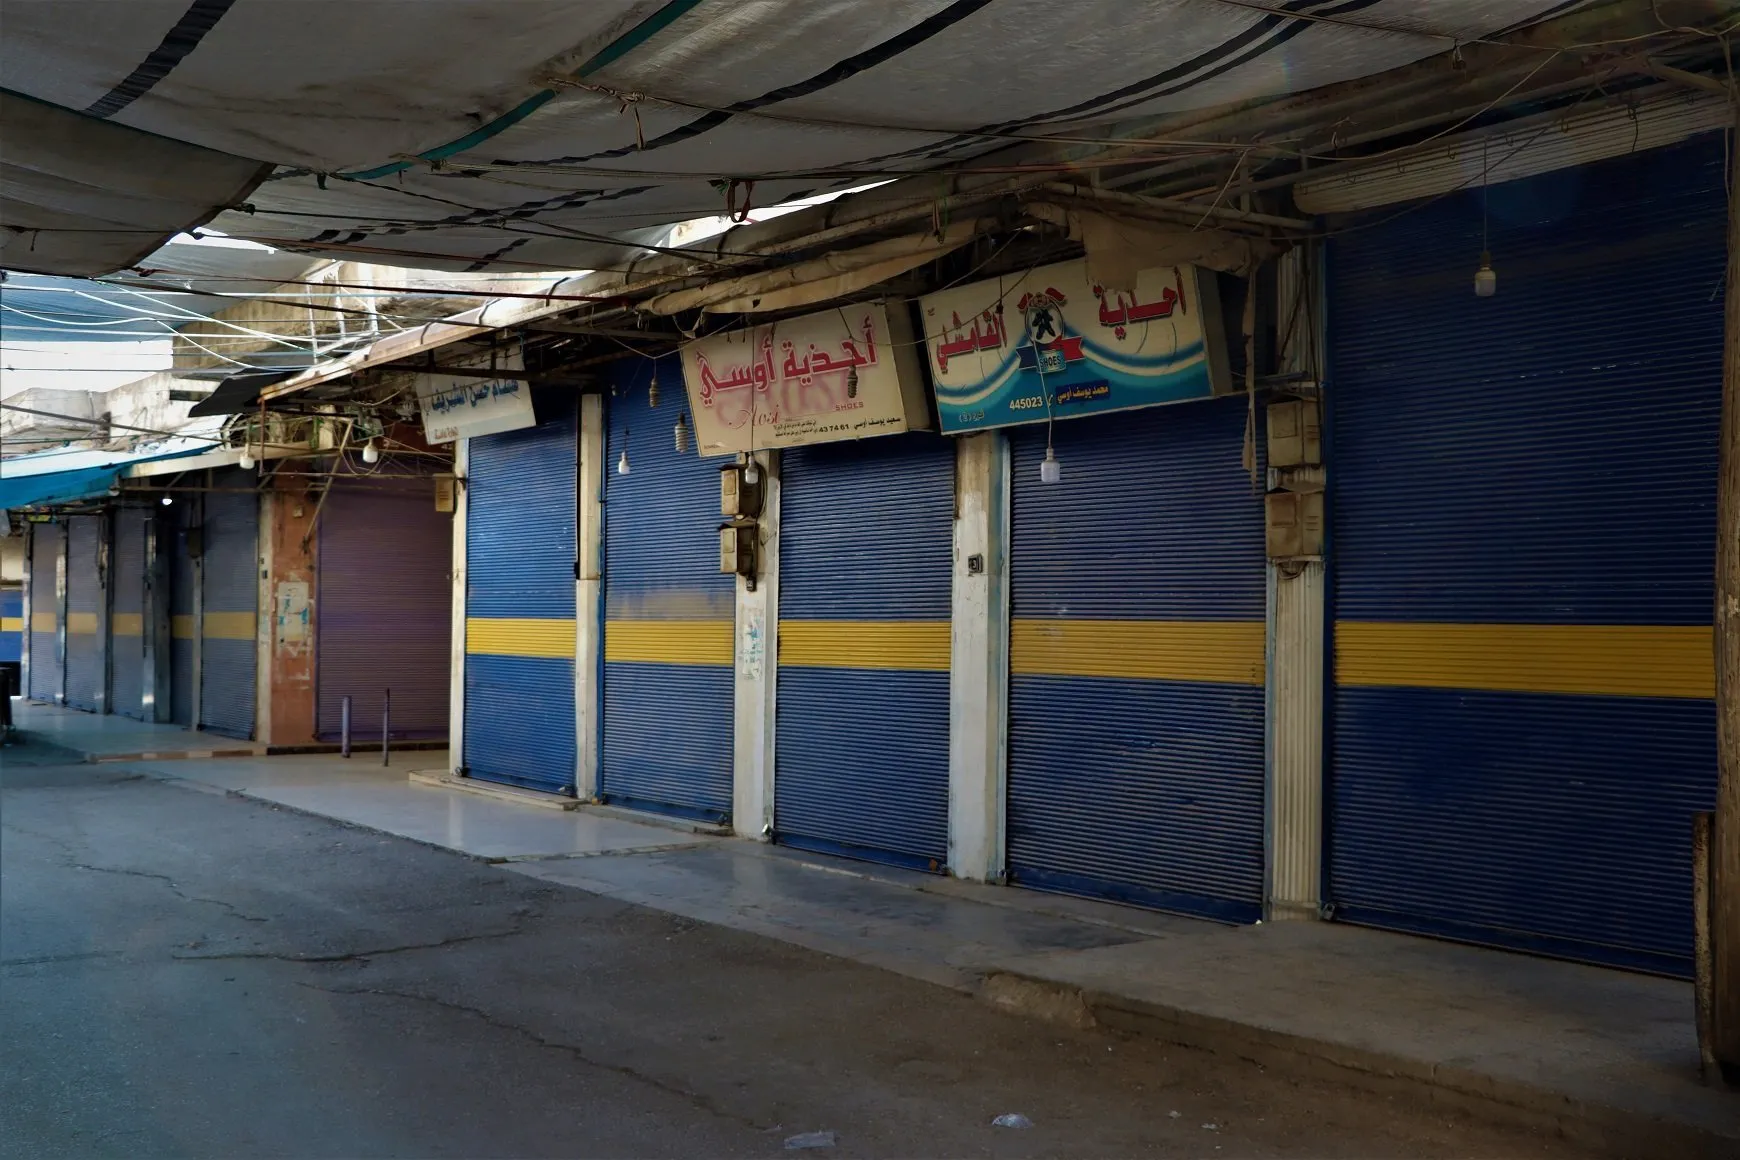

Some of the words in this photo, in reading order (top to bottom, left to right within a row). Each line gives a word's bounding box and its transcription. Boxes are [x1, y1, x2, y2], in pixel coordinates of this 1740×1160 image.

[783, 315, 876, 385] أحذية
[1039, 356, 1062, 368] SHOES
[696, 335, 776, 406] أوسي
[835, 401, 864, 411] SHOES
[1009, 396, 1043, 410] 445023
